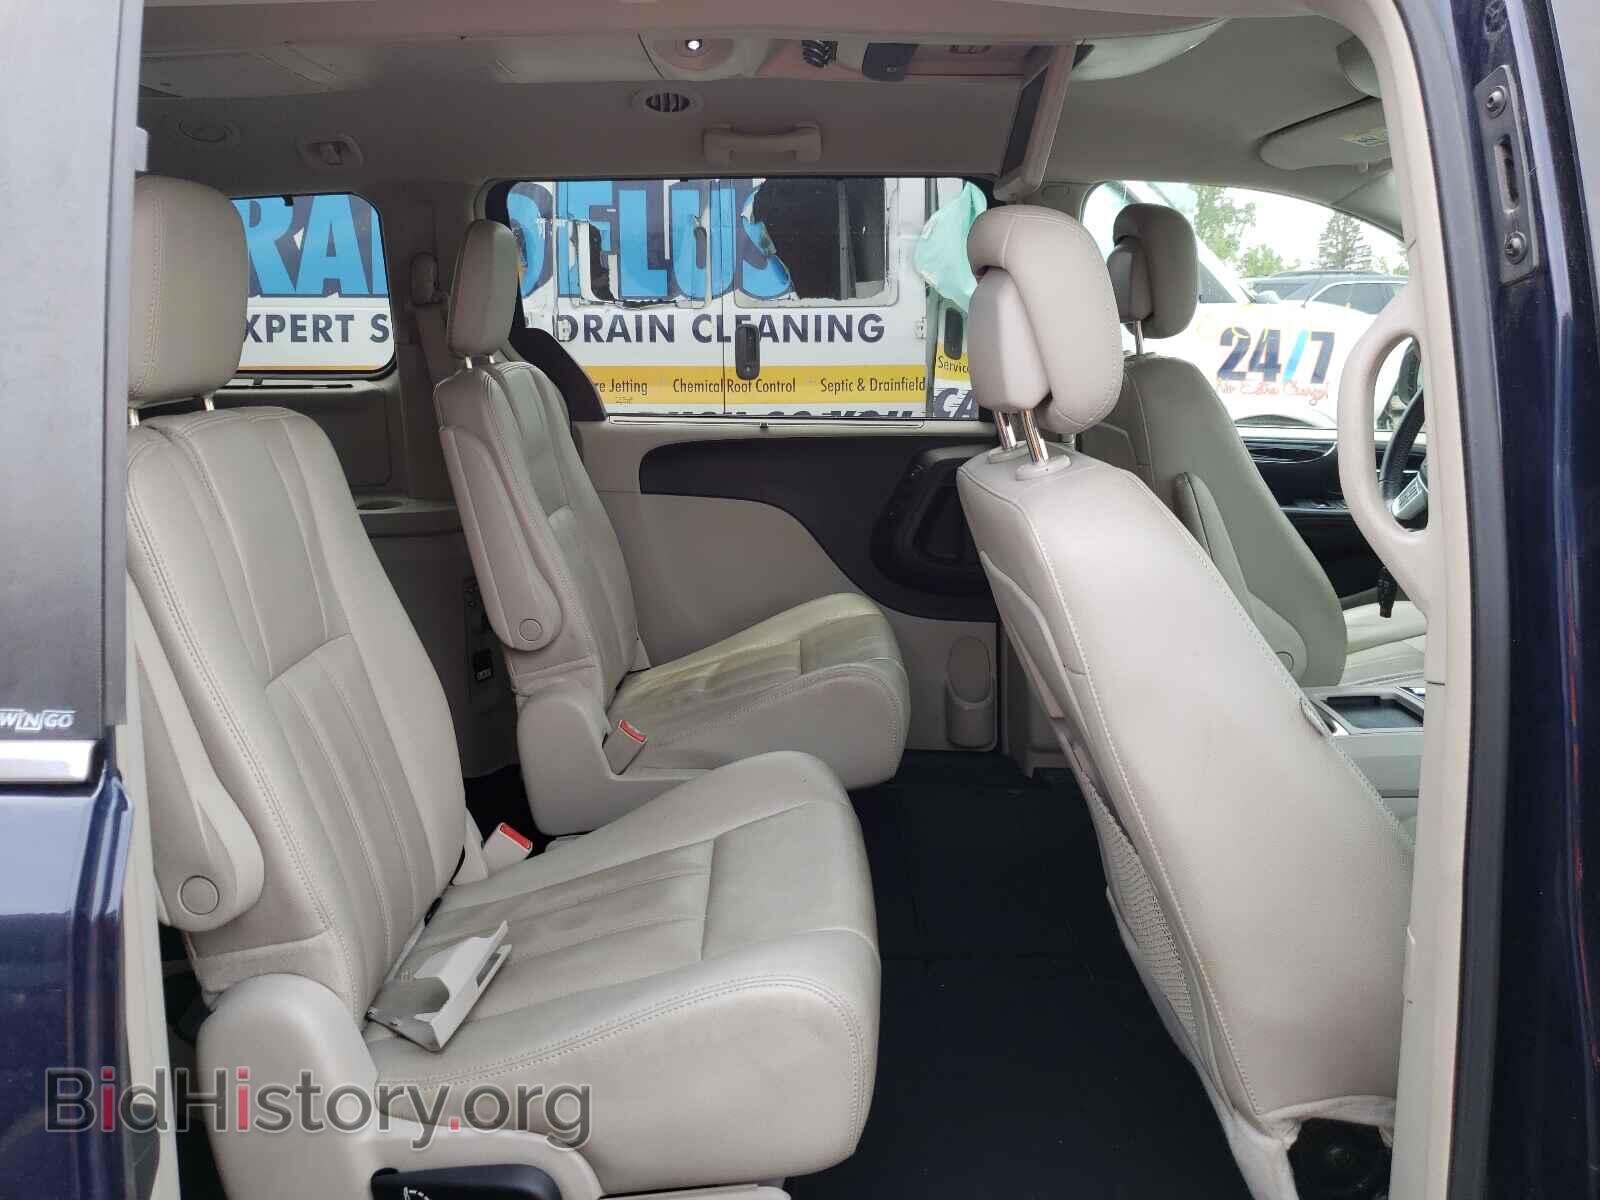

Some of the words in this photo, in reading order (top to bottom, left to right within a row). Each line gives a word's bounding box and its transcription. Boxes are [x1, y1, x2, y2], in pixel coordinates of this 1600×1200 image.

[552, 314, 675, 343] DRAIN
[1216, 326, 1335, 384] 24/7
[609, 378, 648, 395] Jetting
[672, 378, 724, 393] Chemical
[755, 378, 796, 393] Control
[820, 377, 854, 395] Septic
[856, 378, 866, 392] &
[870, 377, 926, 392] Drainfield
